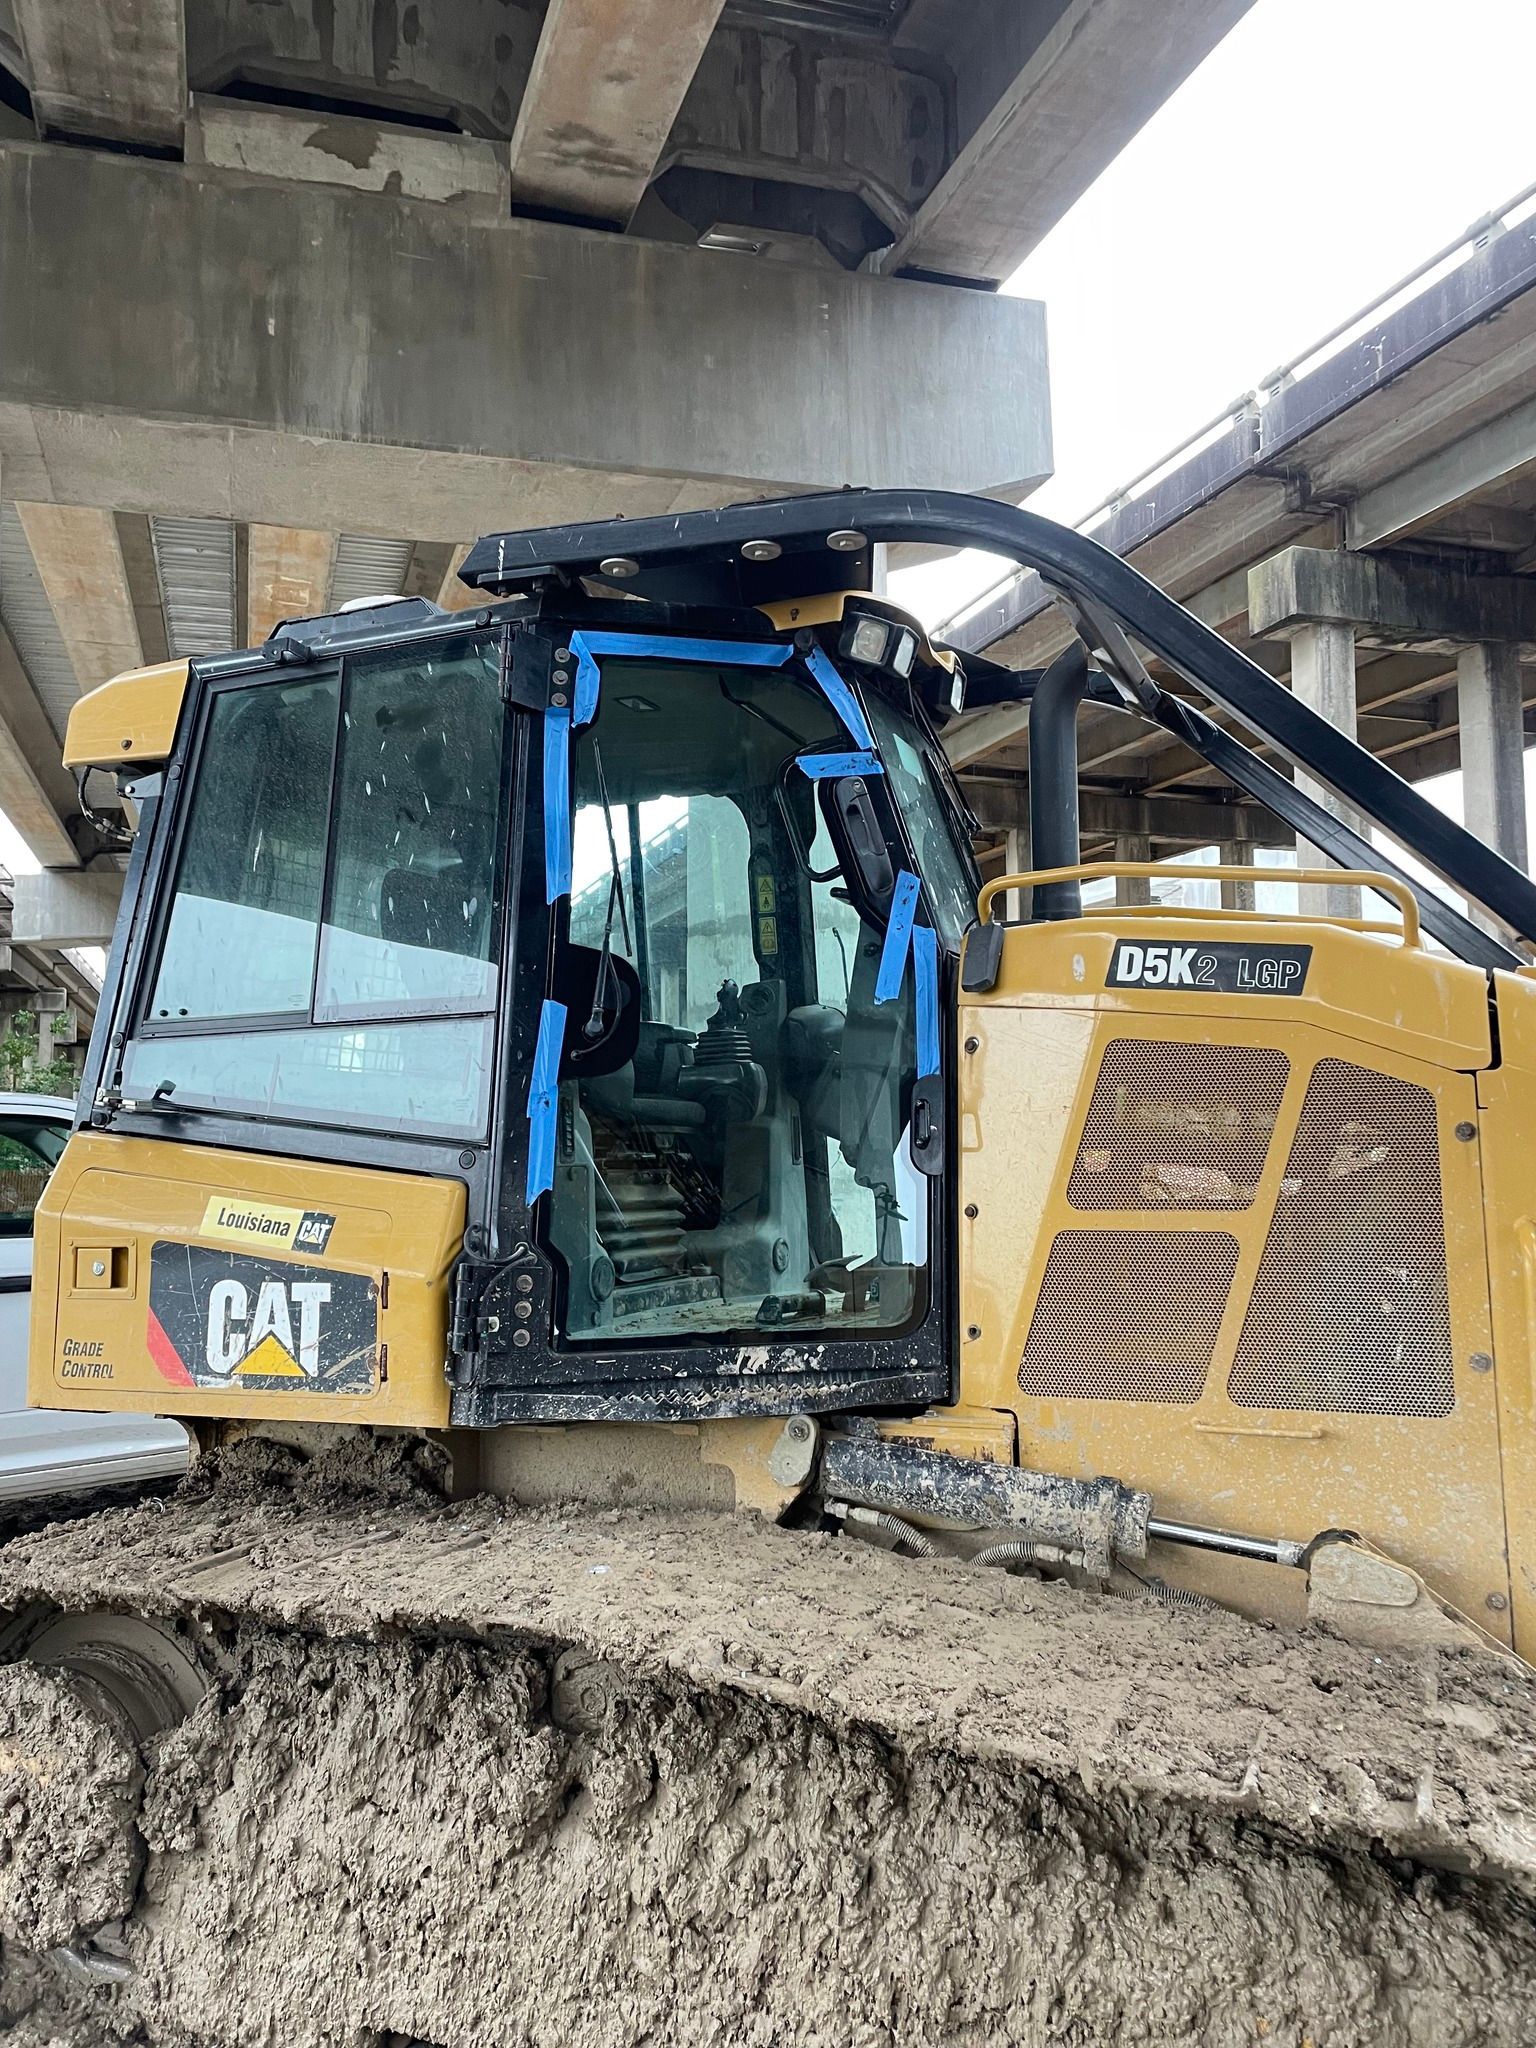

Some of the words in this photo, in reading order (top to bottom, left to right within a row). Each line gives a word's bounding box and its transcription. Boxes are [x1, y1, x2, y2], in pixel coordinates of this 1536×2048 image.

[1237, 958, 1302, 989] LGP
[217, 1207, 291, 1237] Louisiana
[298, 1220, 330, 1245] CAT
[206, 1279, 331, 1377] CAT
[63, 1338, 104, 1357] GRADE
[62, 1359, 114, 1379] CONTROL
